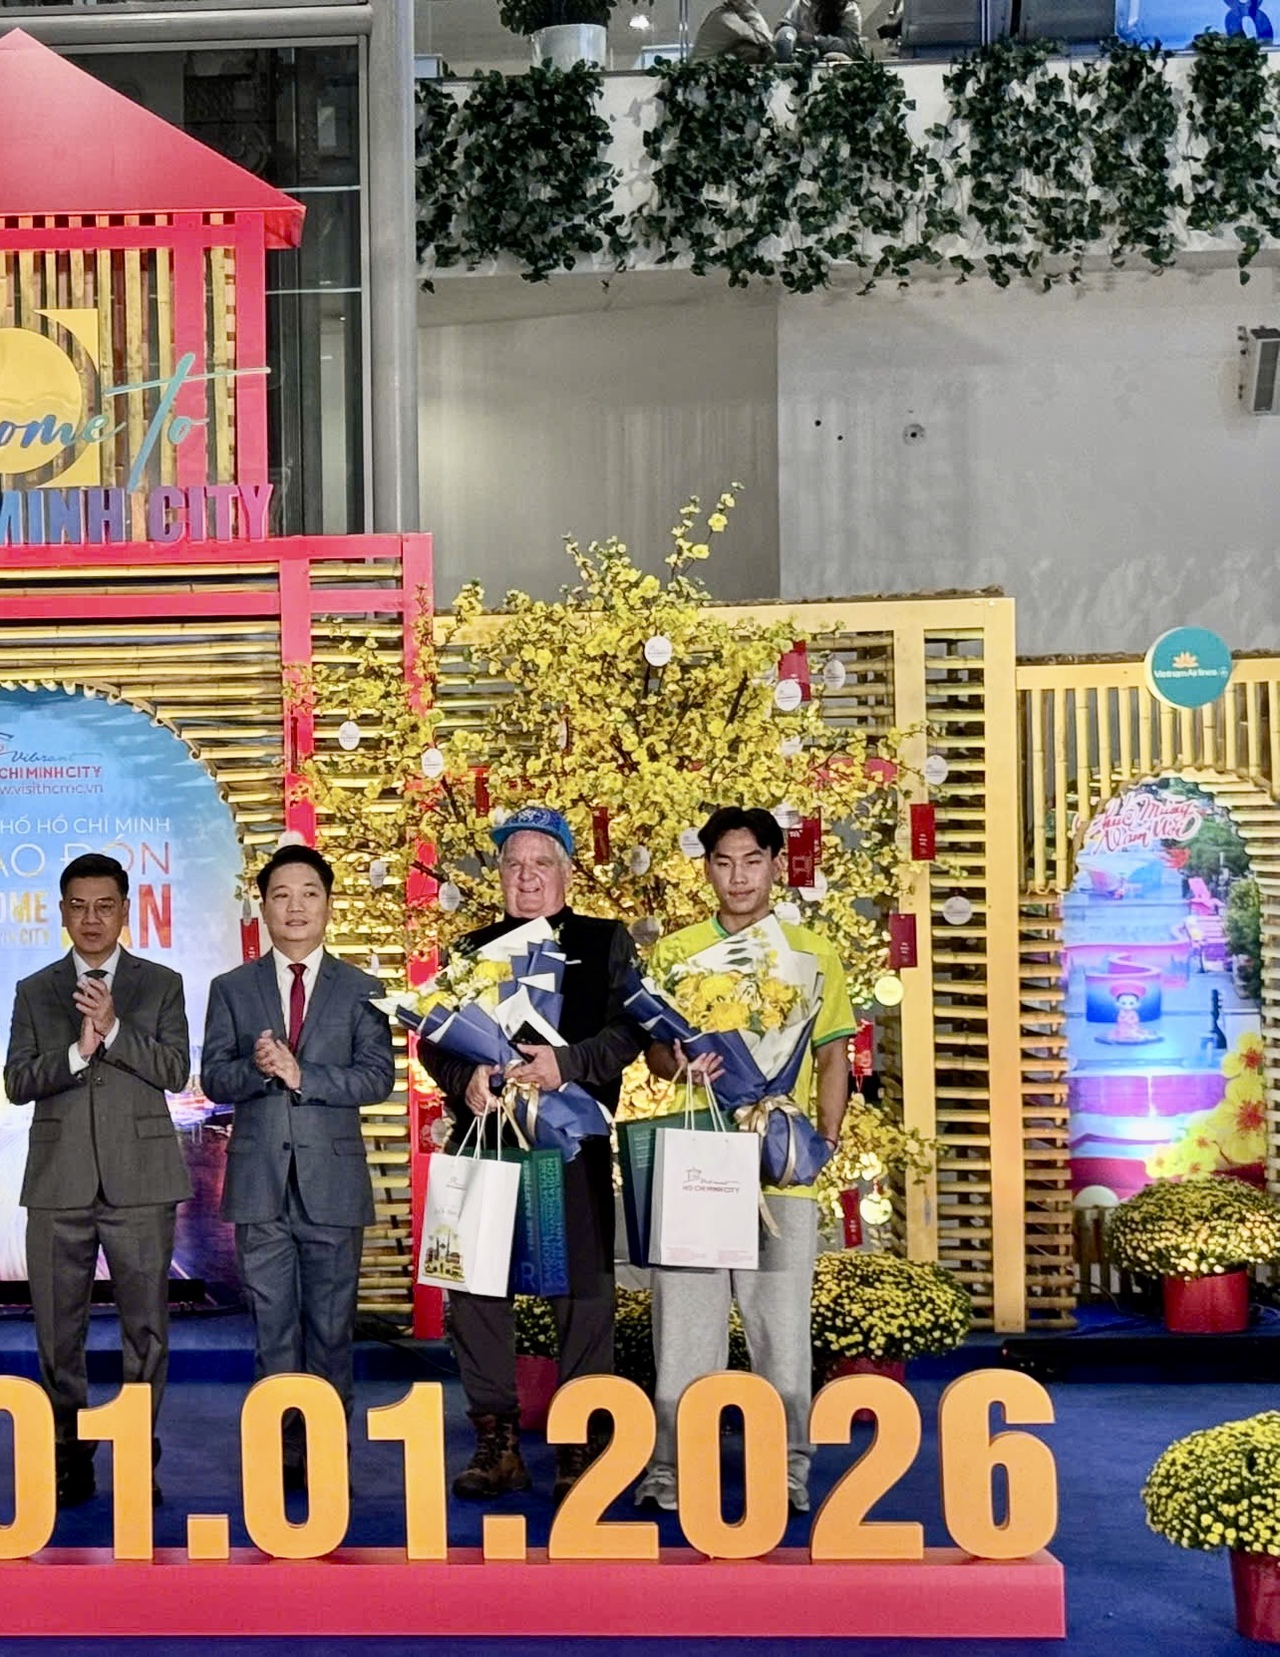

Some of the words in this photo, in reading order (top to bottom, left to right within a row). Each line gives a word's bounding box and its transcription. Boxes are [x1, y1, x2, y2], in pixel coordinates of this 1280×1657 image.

[103, 352, 271, 492] to
[147, 483, 274, 544] CITY
[26, 766, 64, 779] MINH
[66, 766, 102, 778] CITY
[37, 813, 68, 835] HỒ
[74, 815, 109, 834] CHÍ
[115, 817, 170, 833] MINH
[19, 927, 51, 945] CITY
[523, 1160, 533, 1217] PARTNER
